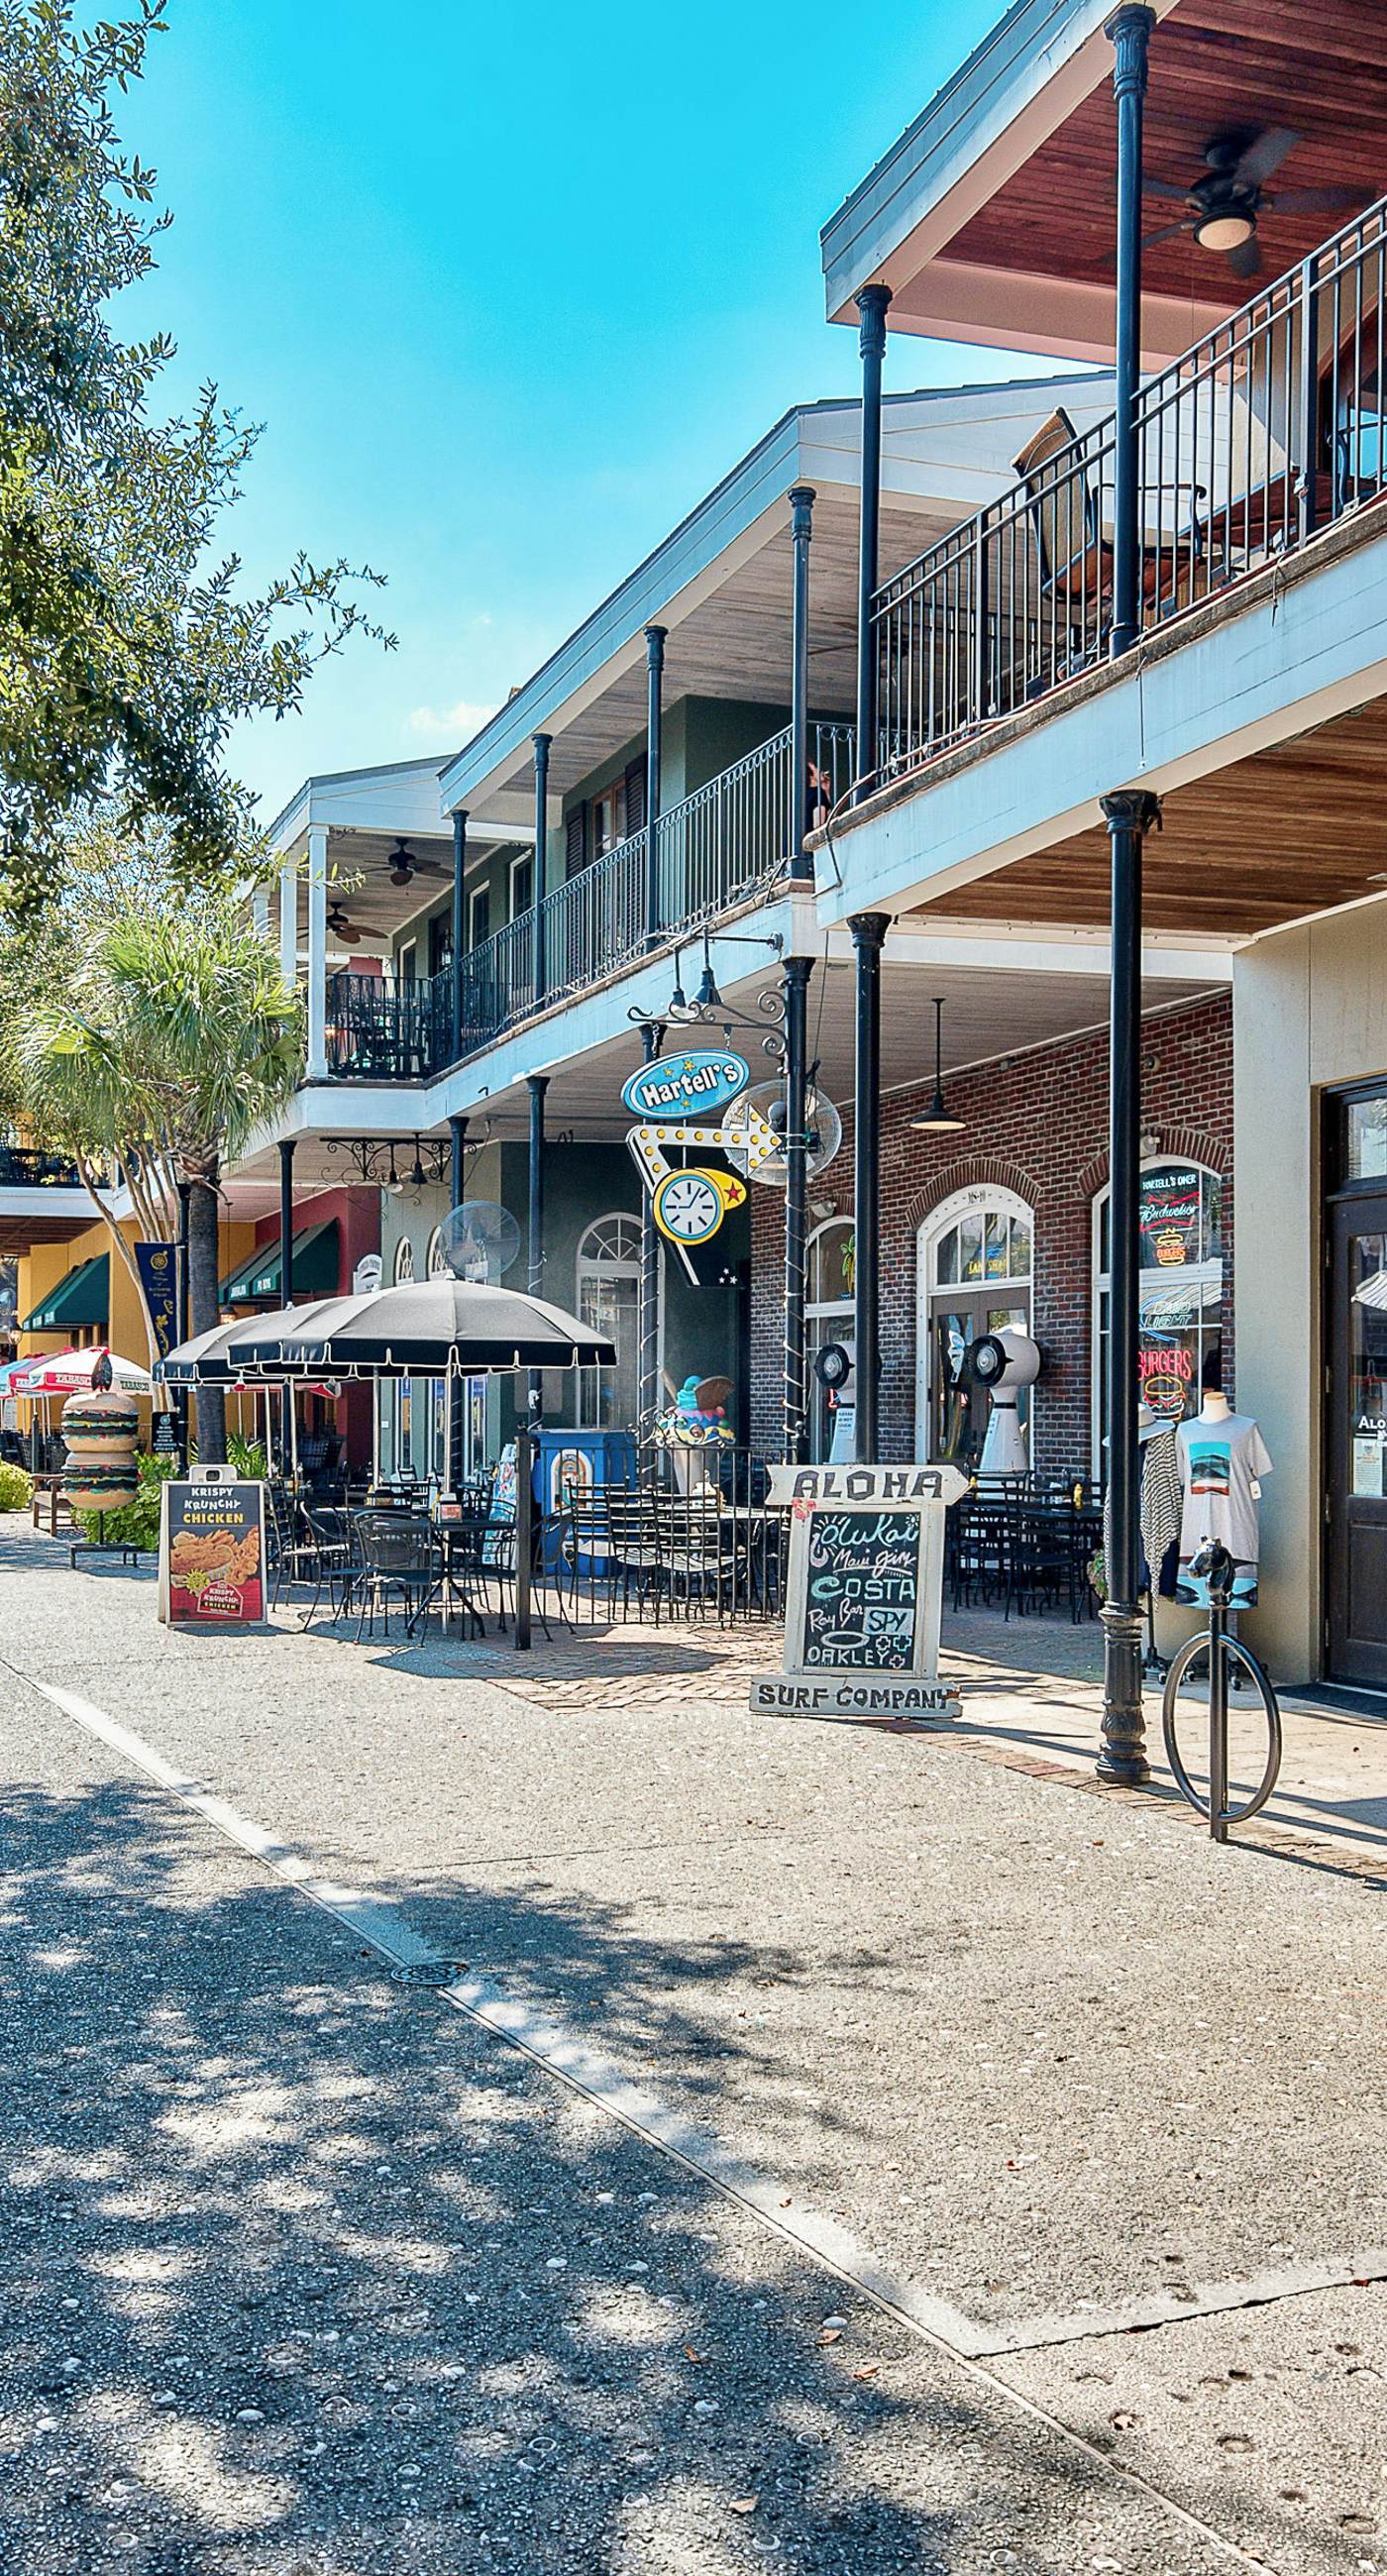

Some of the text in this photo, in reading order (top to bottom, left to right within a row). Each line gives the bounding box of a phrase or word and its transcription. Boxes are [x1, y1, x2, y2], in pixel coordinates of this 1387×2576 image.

[641, 1064, 739, 1108] Hartell's
[1139, 1203, 1198, 1222] Budweiser
[191, 1487, 234, 1496] KRISPY
[793, 1470, 942, 1501] ALOHA
[184, 1499, 241, 1510] KRUNCHY
[183, 1513, 244, 1524] CHICKEN
[833, 1550, 870, 1567] Maui
[810, 1575, 915, 1602] COSTA
[808, 1609, 836, 1633] Ray
[868, 1610, 908, 1633] SPY
[807, 1647, 891, 1665] OAKLEY
[759, 1684, 951, 1710] SURF COMPANY
